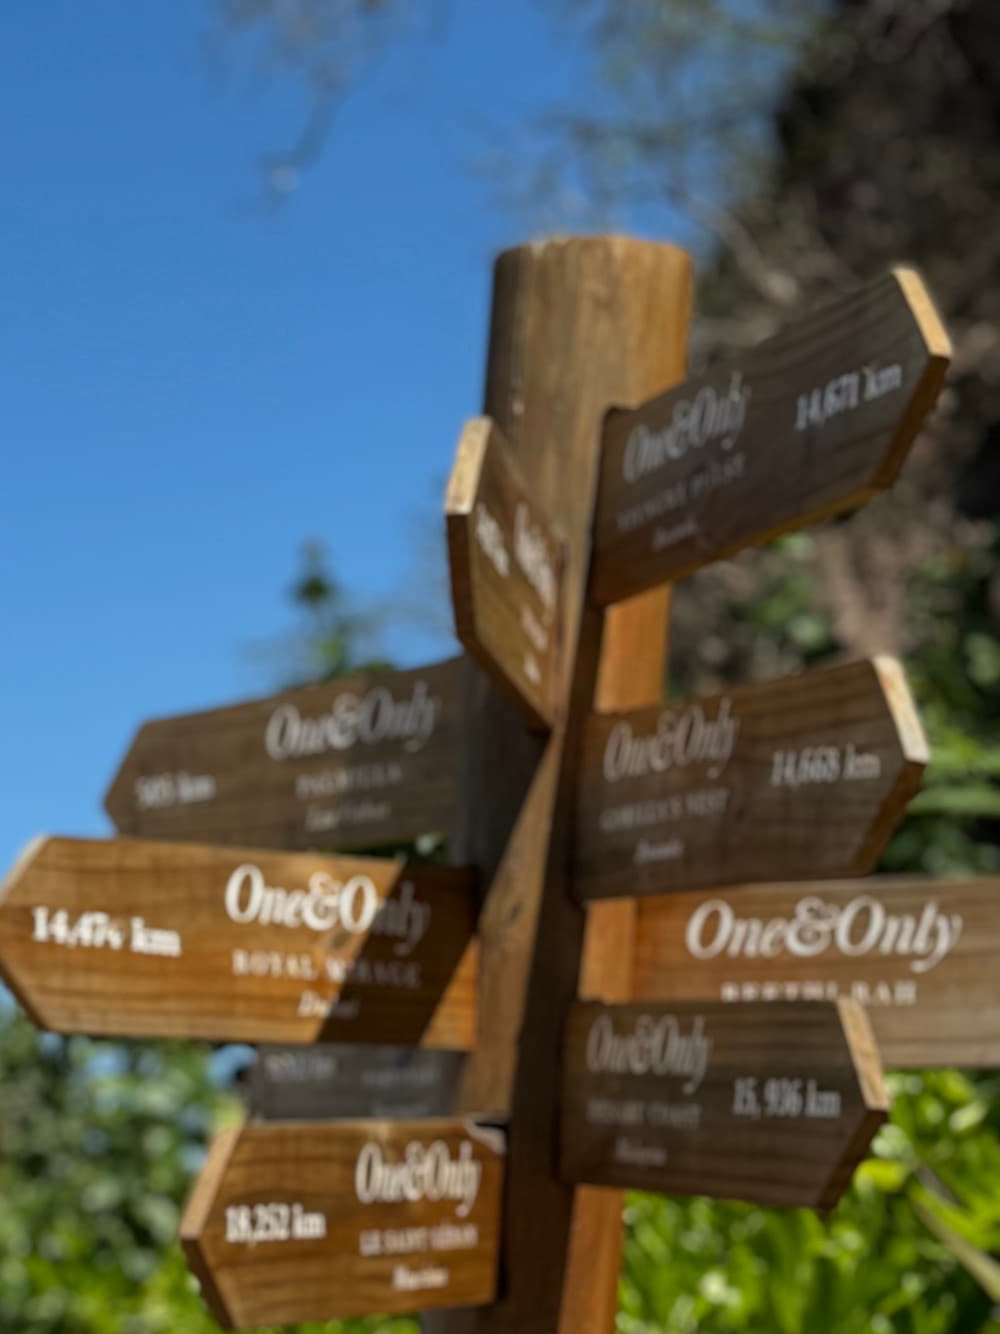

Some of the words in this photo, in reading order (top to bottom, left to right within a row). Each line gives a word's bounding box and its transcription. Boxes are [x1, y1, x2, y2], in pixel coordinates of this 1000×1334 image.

[265, 681, 440, 760] One&Only
[604, 698, 740, 782] One&Only
[842, 741, 882, 780] km
[131, 916, 181, 957] km
[225, 864, 429, 954] One&Only
[686, 895, 962, 973] One&Only
[586, 1013, 714, 1094] One&Only
[805, 1076, 842, 1118] km
[355, 1139, 482, 1218] One&Only
[291, 1202, 327, 1239] km
